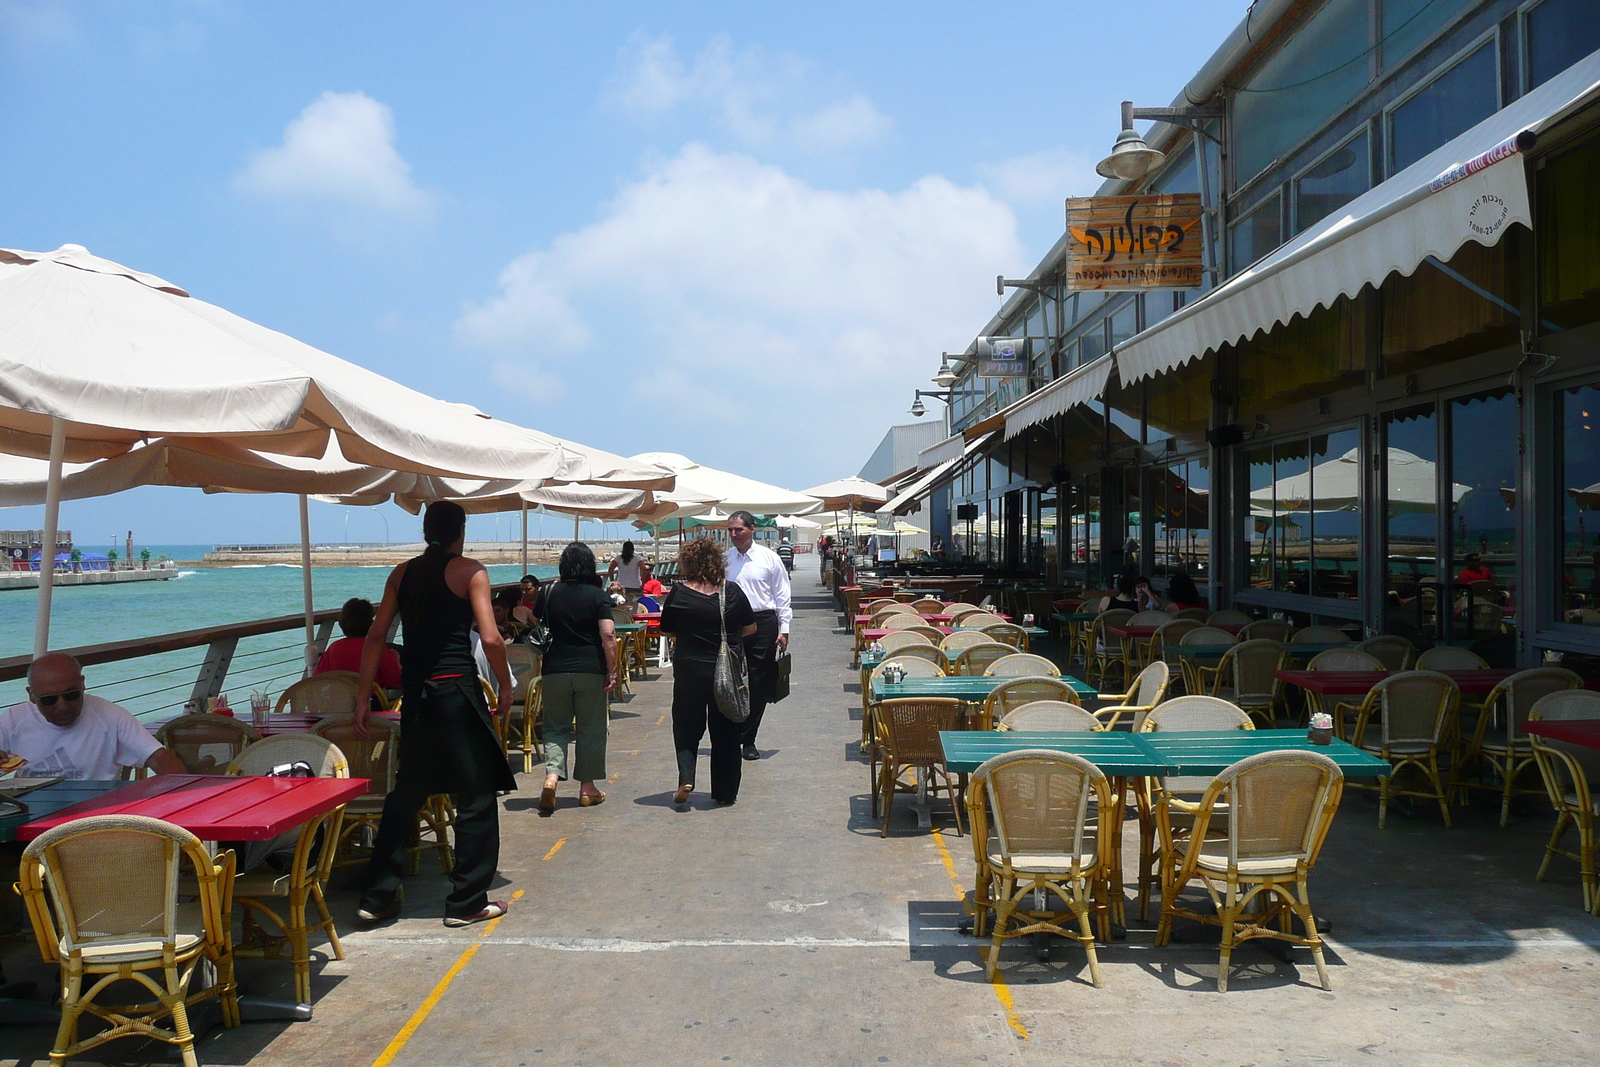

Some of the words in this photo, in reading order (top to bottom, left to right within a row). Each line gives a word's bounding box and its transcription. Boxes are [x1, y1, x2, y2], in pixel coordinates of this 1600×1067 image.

[1469, 199, 1481, 216] זוהר
[1482, 194, 1504, 206] סככות
[1085, 200, 1185, 262] בדולינה
